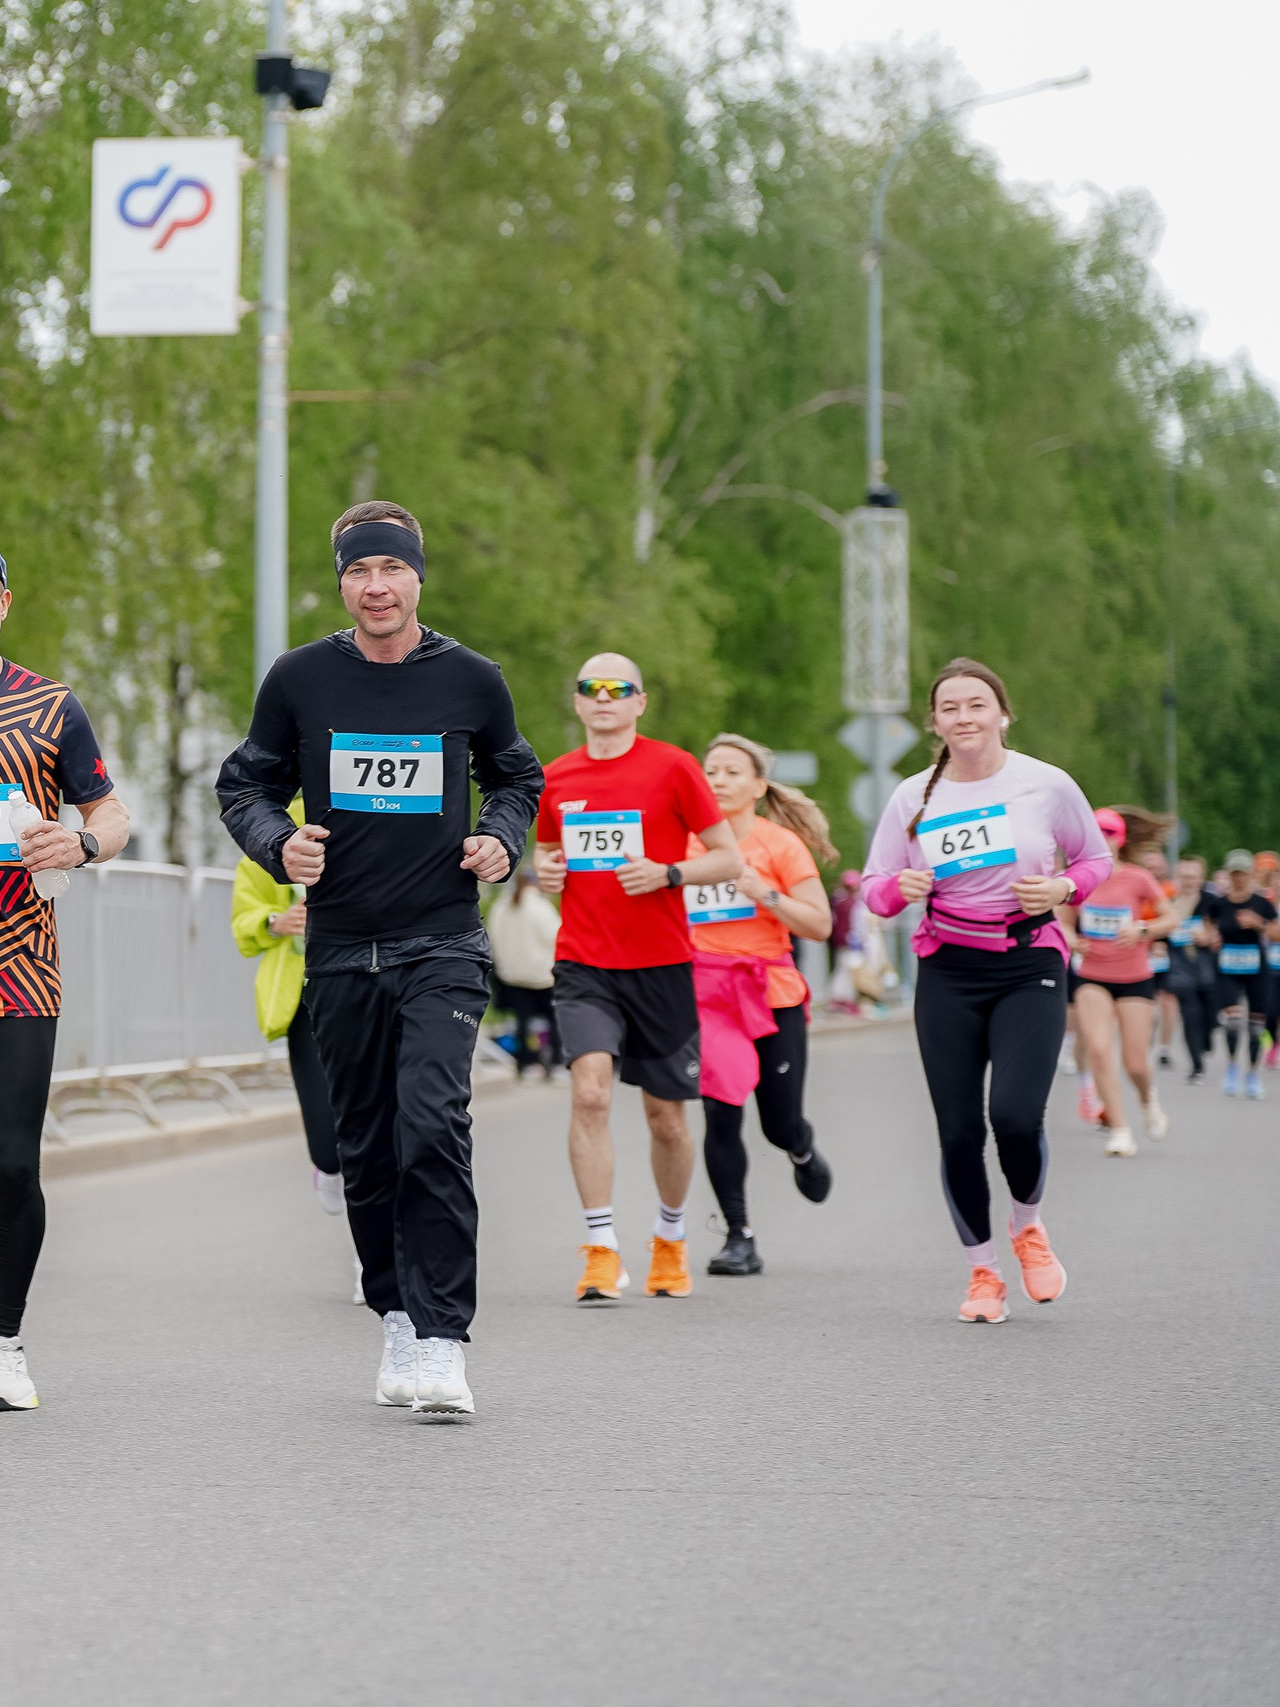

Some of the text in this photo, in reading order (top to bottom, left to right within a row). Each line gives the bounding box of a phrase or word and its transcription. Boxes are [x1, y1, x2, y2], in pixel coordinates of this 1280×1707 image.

[353, 757, 420, 788] 787
[578, 830, 624, 852] 759
[941, 825, 991, 855] 621
[697, 883, 737, 905] 619
